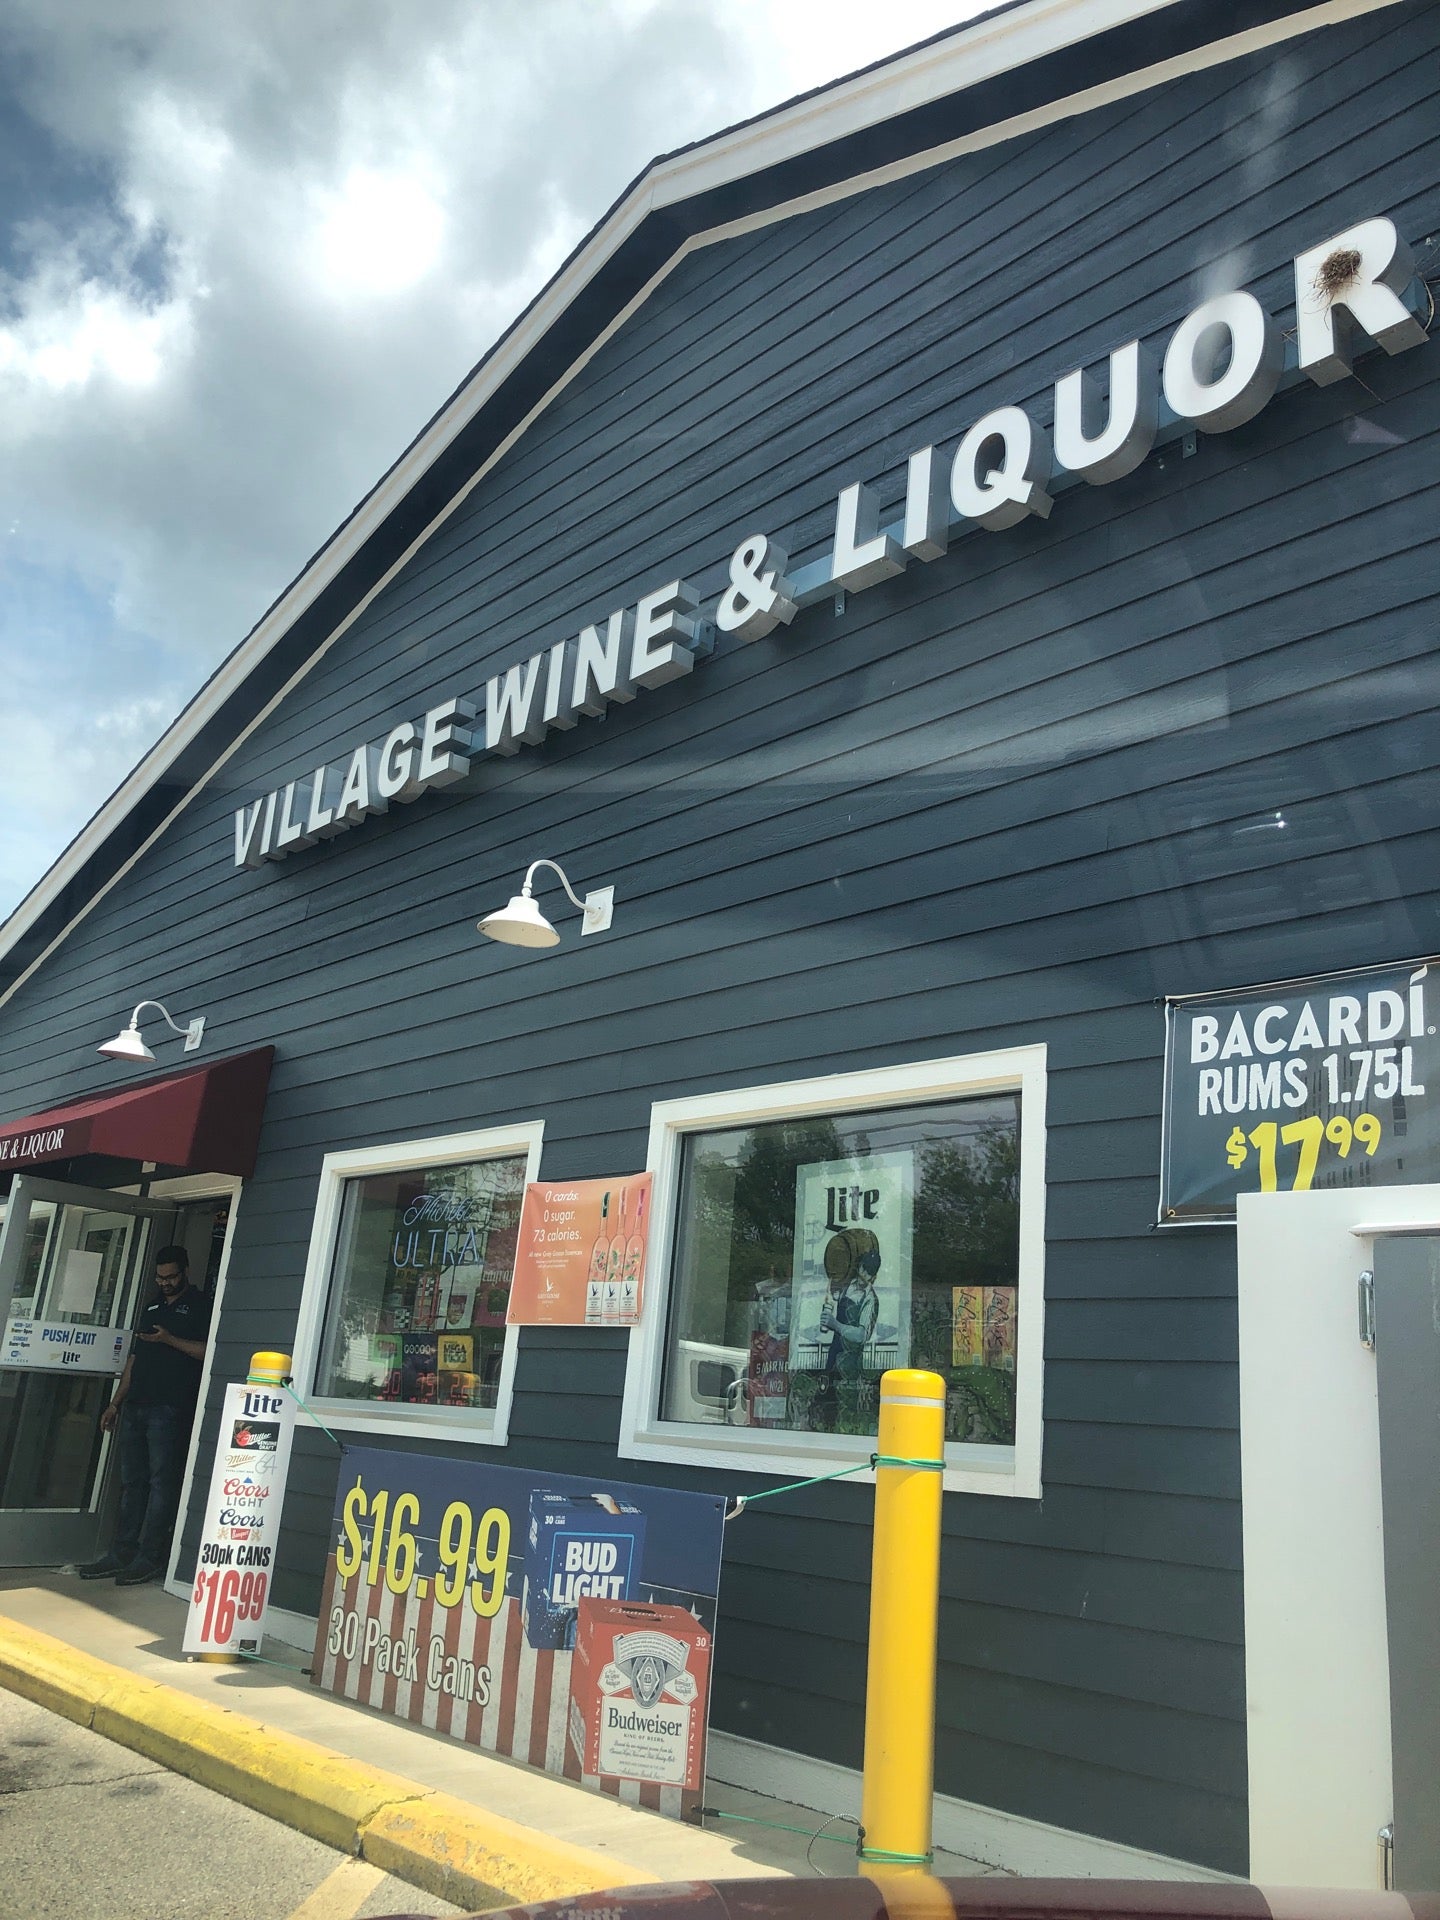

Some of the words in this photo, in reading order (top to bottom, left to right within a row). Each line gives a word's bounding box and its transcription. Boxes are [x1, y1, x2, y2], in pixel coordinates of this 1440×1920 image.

[234, 697, 470, 869] VILLAGE
[485, 578, 697, 752] WINE
[716, 533, 785, 636] &
[831, 215, 1420, 590] LIQUOR
[1198, 1057, 1308, 1116] RUMS
[1322, 1045, 1426, 1105] 1.75L
[10, 1138, 20, 1159] &
[20, 1128, 64, 1159] LIQUOR
[545, 1190, 552, 1203] 0
[824, 1184, 881, 1233] Lite
[543, 1209, 549, 1223] 0
[551, 1210, 576, 1225] sugar.
[393, 1227, 480, 1268] ULTRA
[533, 1229, 545, 1243] 73
[547, 1227, 582, 1242] calories.
[62, 1351, 81, 1364] Lite
[242, 1393, 283, 1418] Lite
[225, 1454, 256, 1468] Miller
[255, 1453, 278, 1475] 64
[223, 1478, 270, 1498] Coors
[226, 1496, 264, 1508] LIGHT
[219, 1508, 265, 1528] Coors
[544, 1515, 554, 1525] 30
[201, 1543, 234, 1568] 30pk
[236, 1545, 272, 1567] CANS
[335, 1474, 512, 1618] $16.99
[565, 1541, 618, 1573] BUD
[552, 1573, 625, 1609] LIGHT
[695, 1636, 707, 1648] 30
[328, 1606, 358, 1662] 30
[362, 1617, 420, 1684] Pack
[427, 1635, 492, 1707] Cans
[608, 1707, 683, 1737] Budweiser
